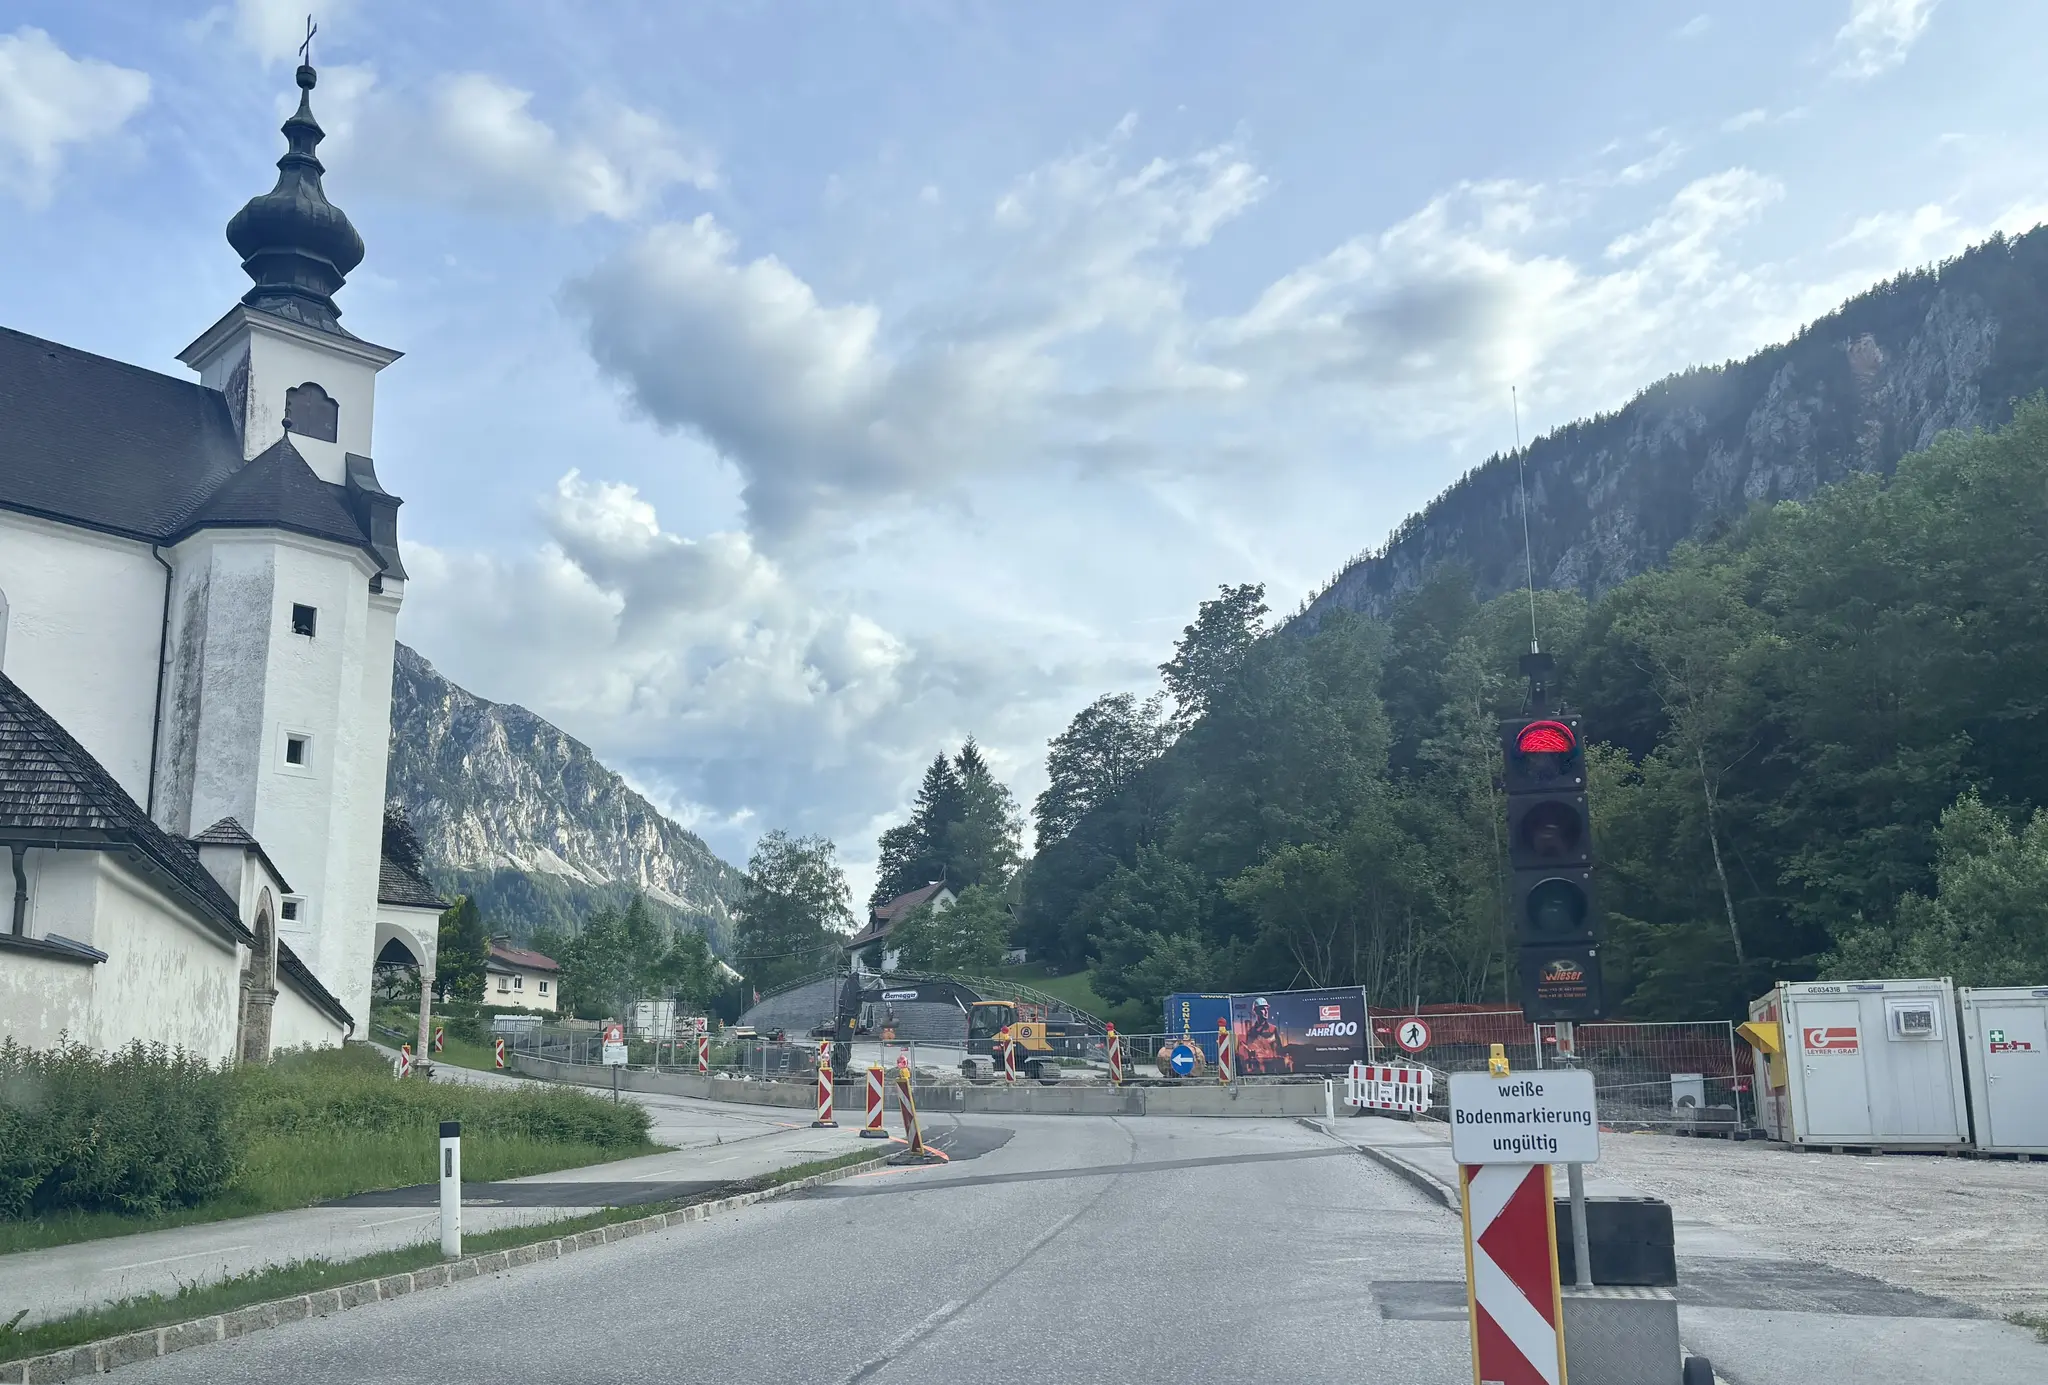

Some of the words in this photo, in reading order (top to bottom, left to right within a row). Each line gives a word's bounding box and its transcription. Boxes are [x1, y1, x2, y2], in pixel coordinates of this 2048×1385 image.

[1544, 970, 1582, 981] Wieser
[1498, 1081, 1544, 1097] weiße
[1456, 1108, 1592, 1126] Bodenmarkierung
[1494, 1134, 1558, 1154] ungültig
